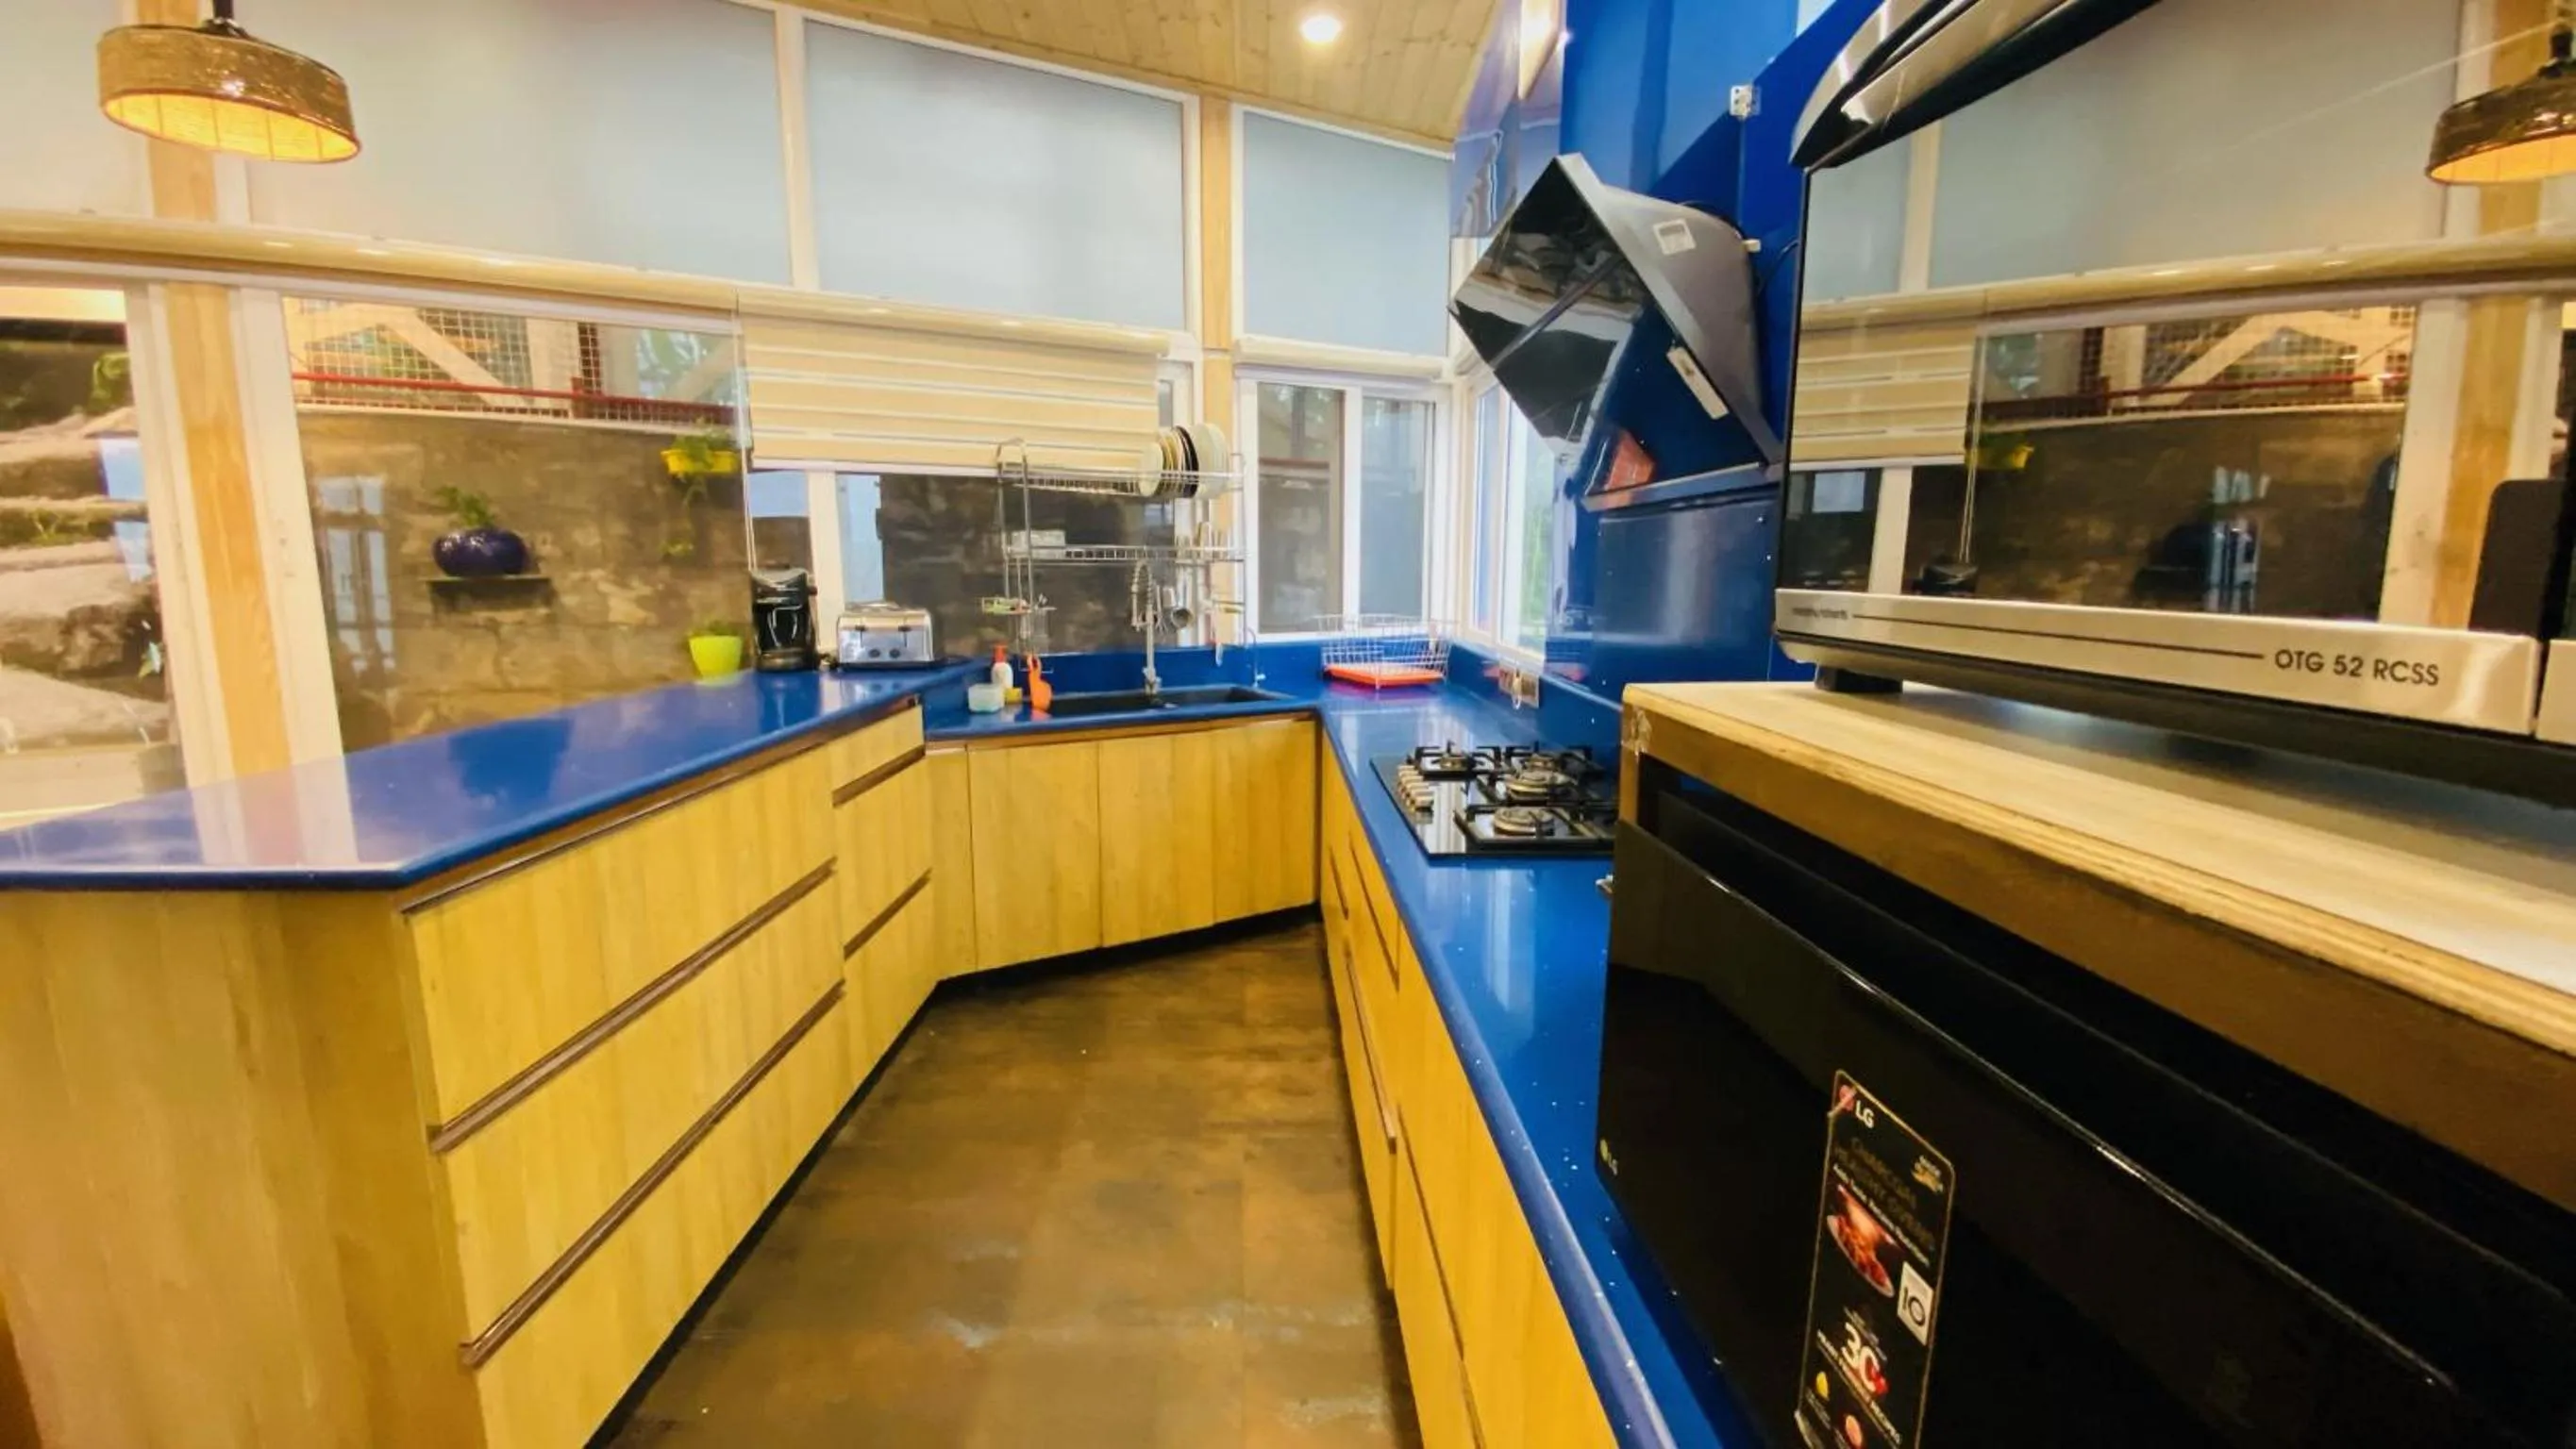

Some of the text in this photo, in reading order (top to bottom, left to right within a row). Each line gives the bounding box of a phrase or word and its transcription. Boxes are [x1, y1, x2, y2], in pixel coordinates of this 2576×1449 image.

[2274, 648, 2439, 686] OTG 52 RCSS
[1855, 1099, 1875, 1129] LG
